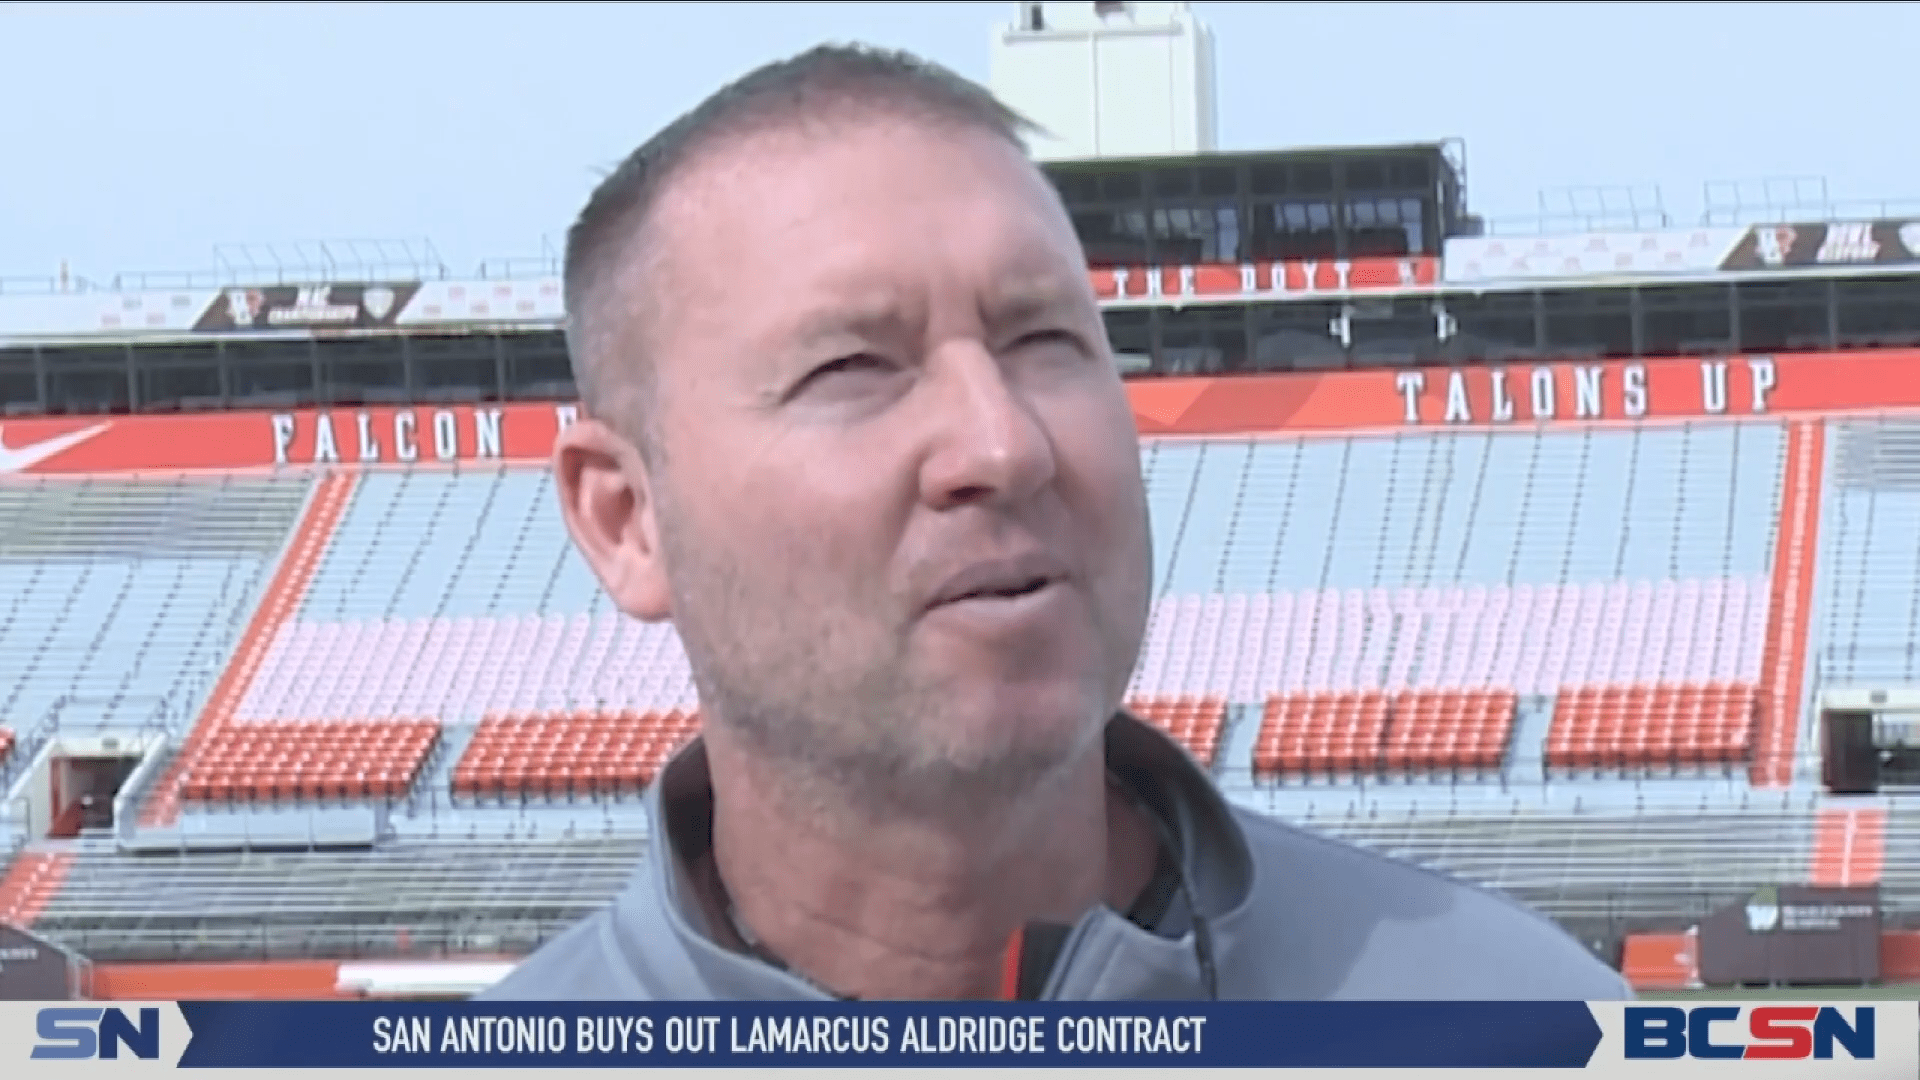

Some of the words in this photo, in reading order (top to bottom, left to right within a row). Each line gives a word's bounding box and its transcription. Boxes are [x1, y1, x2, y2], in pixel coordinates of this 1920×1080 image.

[1113, 266, 1195, 298] THE
[1240, 260, 1351, 292] DOYT
[1396, 365, 1648, 424] TALONS
[1702, 357, 1777, 414] UP
[272, 407, 504, 464] FALCON
